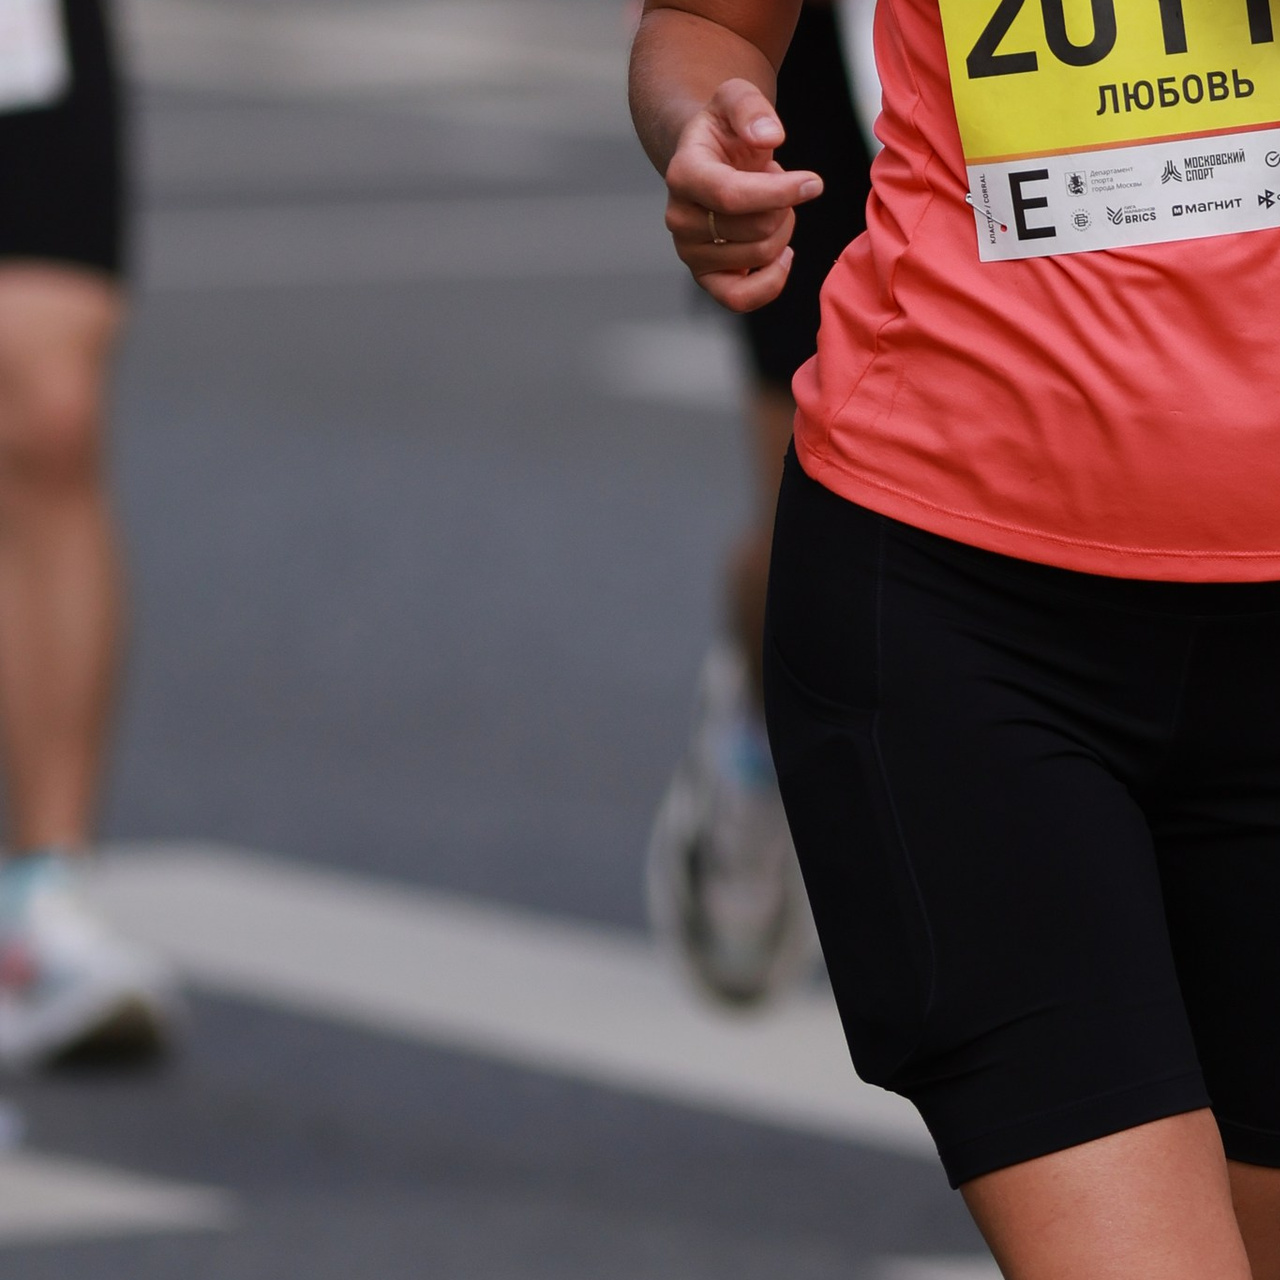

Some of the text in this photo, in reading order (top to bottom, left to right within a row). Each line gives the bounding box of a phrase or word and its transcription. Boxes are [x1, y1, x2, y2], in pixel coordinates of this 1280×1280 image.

[1096, 68, 1255, 116] ЛЮБОВЬ
[1184, 148, 1246, 169] МОСКОВСКИЙ
[1186, 167, 1214, 181] СПОРТ
[980, 174, 990, 204] CORRAL
[1008, 169, 1056, 241] E
[1125, 212, 1157, 224] BRICS
